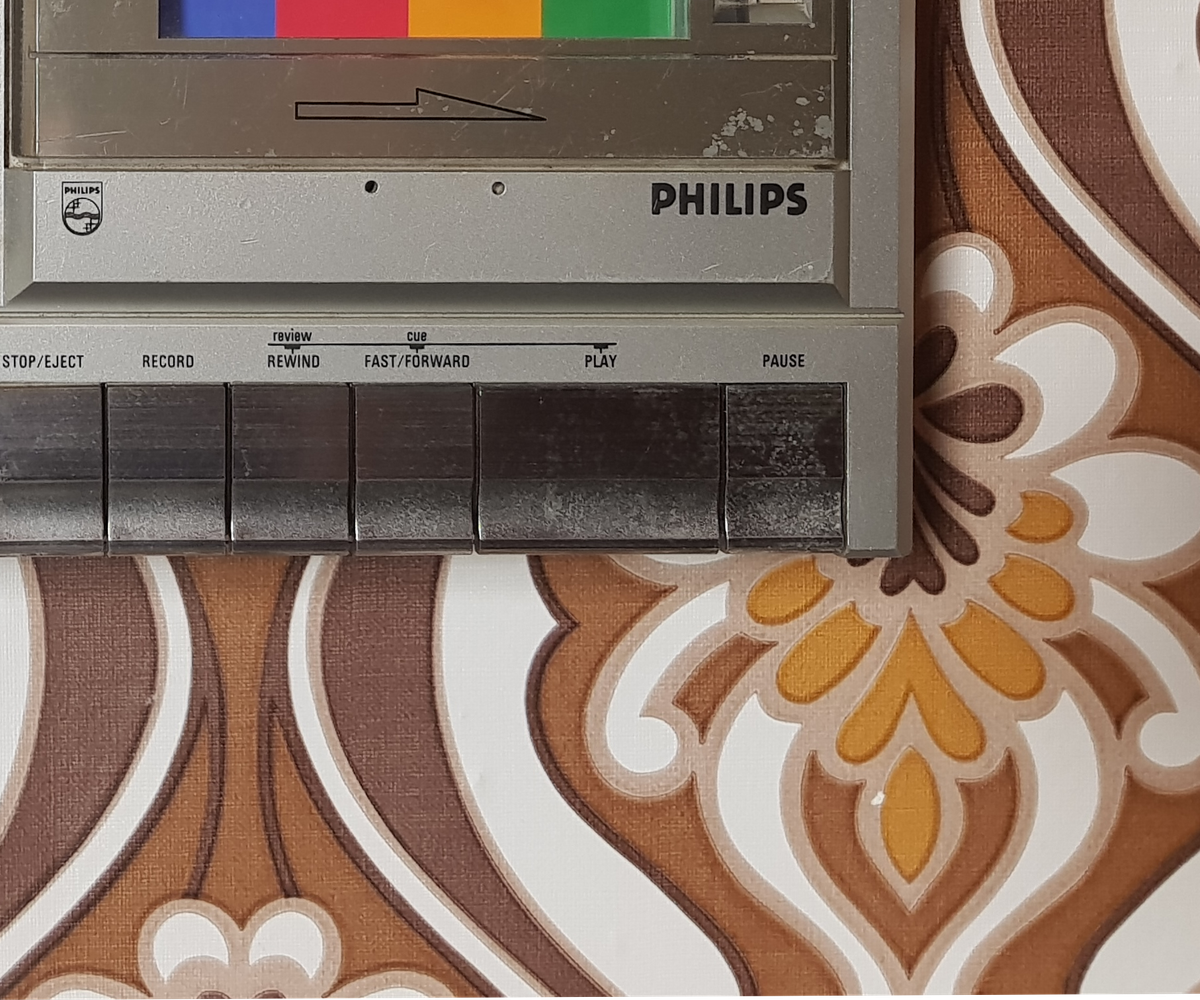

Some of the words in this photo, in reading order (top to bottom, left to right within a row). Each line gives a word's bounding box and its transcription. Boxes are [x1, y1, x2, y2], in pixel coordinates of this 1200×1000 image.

[64, 186, 101, 195] PHILIPS
[651, 182, 808, 216] PHILIPS
[272, 327, 313, 342] review
[406, 331, 428, 342] cue
[2, 354, 84, 369] STOP/EJECT
[142, 354, 194, 369] RECORD
[267, 354, 320, 369] REWIND
[364, 354, 470, 369] FAST/FORWARD
[584, 354, 618, 369] PLAY
[762, 353, 806, 368] PAUSE
